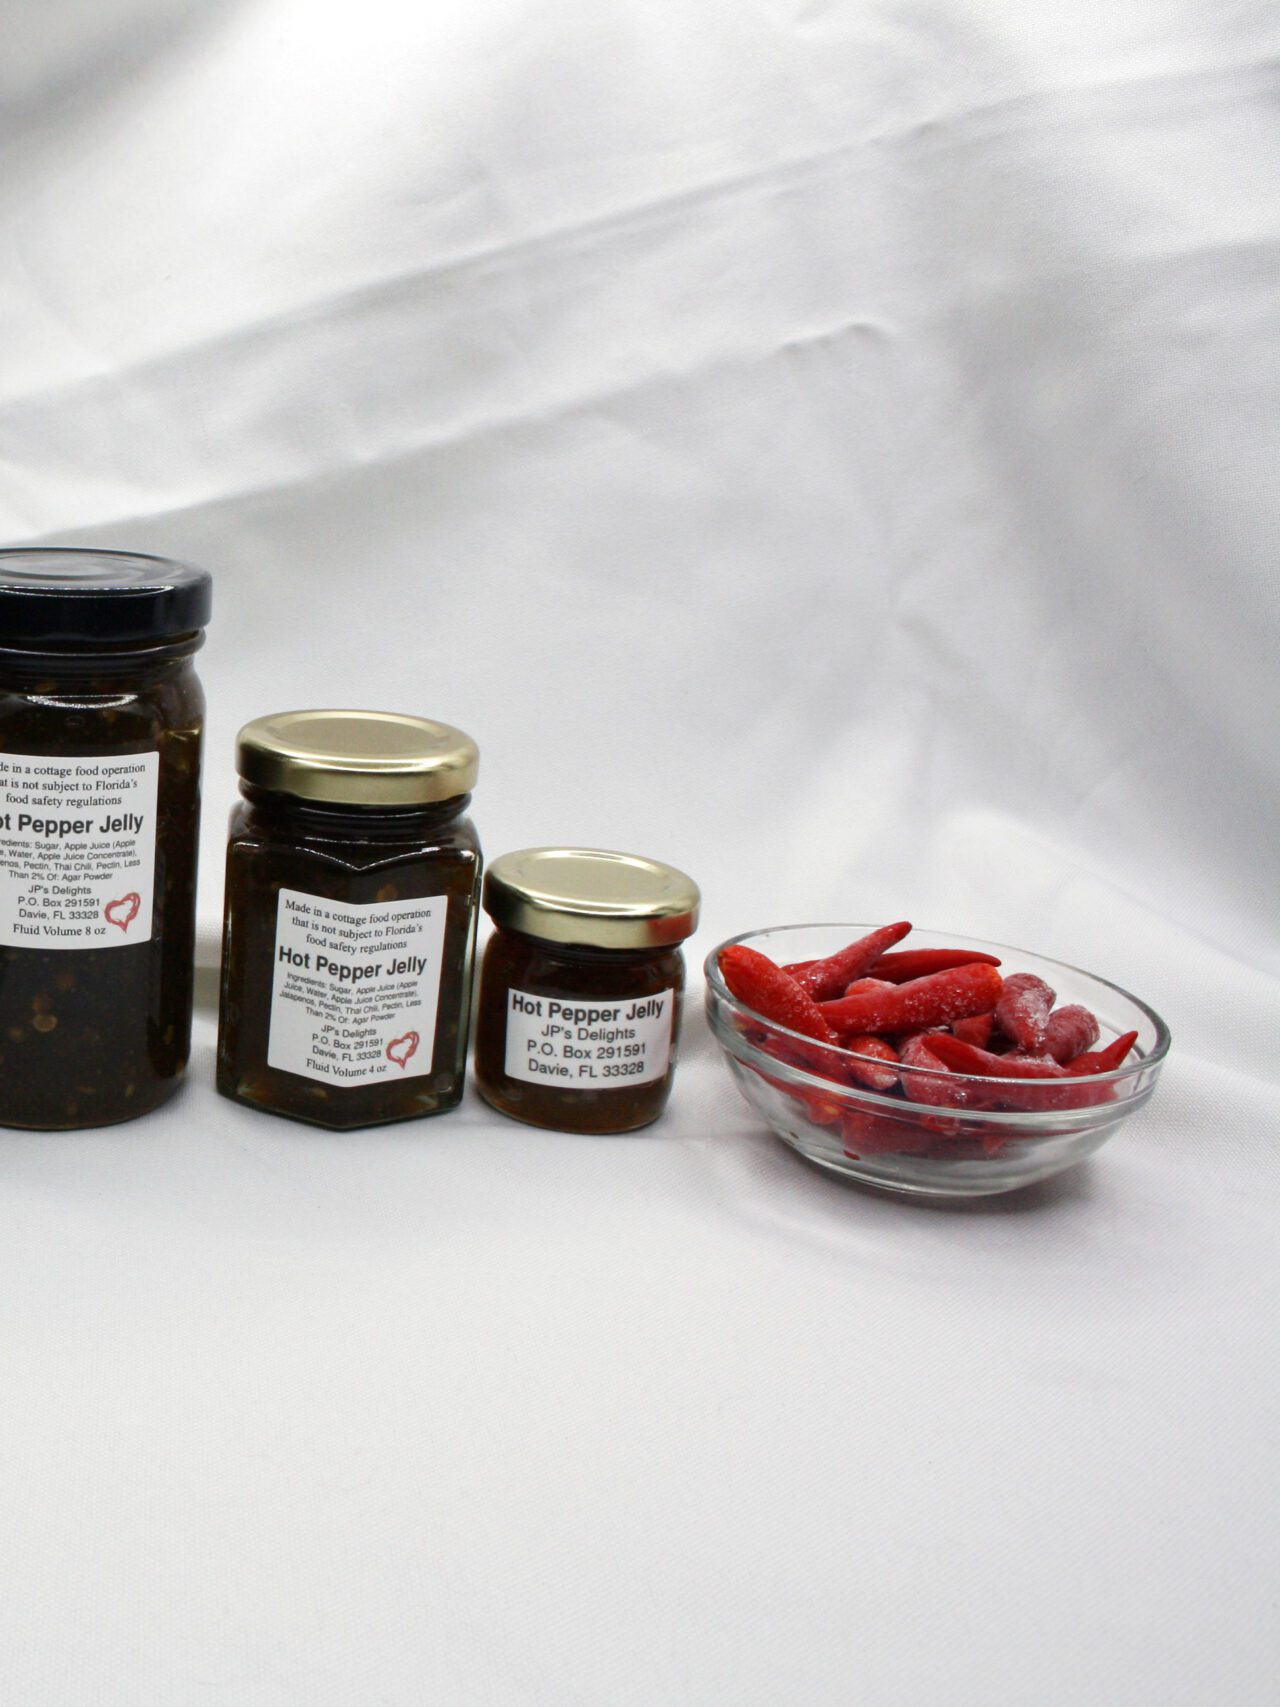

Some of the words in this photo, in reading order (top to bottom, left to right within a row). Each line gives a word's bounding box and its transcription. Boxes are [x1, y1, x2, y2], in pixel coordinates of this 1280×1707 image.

[12, 764, 21, 773] in
[34, 767, 72, 778] cottage
[76, 767, 98, 775] food
[102, 765, 145, 778] operation
[11, 779, 19, 788] is
[22, 782, 38, 790] not
[42, 782, 80, 791] subject
[96, 779, 137, 790] Florida's
[6, 793, 29, 805] food
[32, 796, 62, 808] safety
[66, 795, 122, 808] regulations
[18, 814, 93, 837] Pepper
[100, 814, 143, 833] Jelly
[64, 841, 87, 851] Apple
[89, 841, 110, 849] Juice
[112, 839, 135, 849] (Apple
[37, 852, 61, 861] Apple
[63, 852, 84, 860] Juice
[124, 859, 140, 868] Less
[9, 870, 29, 879] Than
[61, 873, 81, 882] Agar
[84, 872, 113, 880] Powder
[28, 885, 49, 894] JP's
[52, 886, 91, 896] Delights
[18, 897, 39, 906] P.O.
[43, 899, 61, 907] Box
[65, 899, 99, 907] 291591
[19, 910, 49, 920] Davie,
[53, 911, 65, 919] FL
[69, 911, 99, 919] 33328
[285, 900, 311, 914] Made
[313, 907, 322, 916] in
[333, 913, 367, 927] cottage
[370, 913, 389, 923] food
[391, 909, 431, 922] operation
[13, 924, 40, 935] Fluid
[43, 925, 82, 936] Volume
[85, 927, 91, 935] 8
[94, 927, 106, 935] oz
[292, 916, 308, 928] that
[312, 921, 319, 931] is
[322, 925, 336, 934] not
[339, 928, 372, 941] subject
[374, 929, 383, 937] to
[386, 923, 423, 936] Florida's
[306, 934, 326, 947] food
[329, 941, 357, 955] safety
[359, 940, 407, 954] regulations
[279, 946, 310, 969] Hot
[316, 955, 381, 983] Pepper
[387, 956, 427, 975] Jelly
[512, 994, 542, 1017] Hot
[549, 1002, 620, 1026] Pepper
[626, 1000, 664, 1020] Jelly
[321, 1025, 339, 1037] JP's
[342, 1027, 376, 1039] Delights
[541, 1025, 572, 1040] JP's
[578, 1028, 636, 1043] Delights
[312, 1034, 330, 1046] P.O.
[334, 1040, 351, 1050] Box
[353, 1039, 383, 1049] 291591
[527, 1040, 558, 1057] P.O.
[563, 1046, 591, 1059] Box
[597, 1043, 646, 1059] 291591
[312, 1045, 339, 1060] Davie,
[342, 1053, 354, 1062] FL
[356, 1050, 381, 1061] 33328
[306, 1059, 329, 1073] Fluid
[333, 1067, 367, 1077] Volume
[369, 1065, 374, 1073] 4
[377, 1064, 387, 1072] oz
[528, 1058, 572, 1078] Davie,
[579, 1065, 598, 1078] FL
[602, 1062, 644, 1078] 33328
